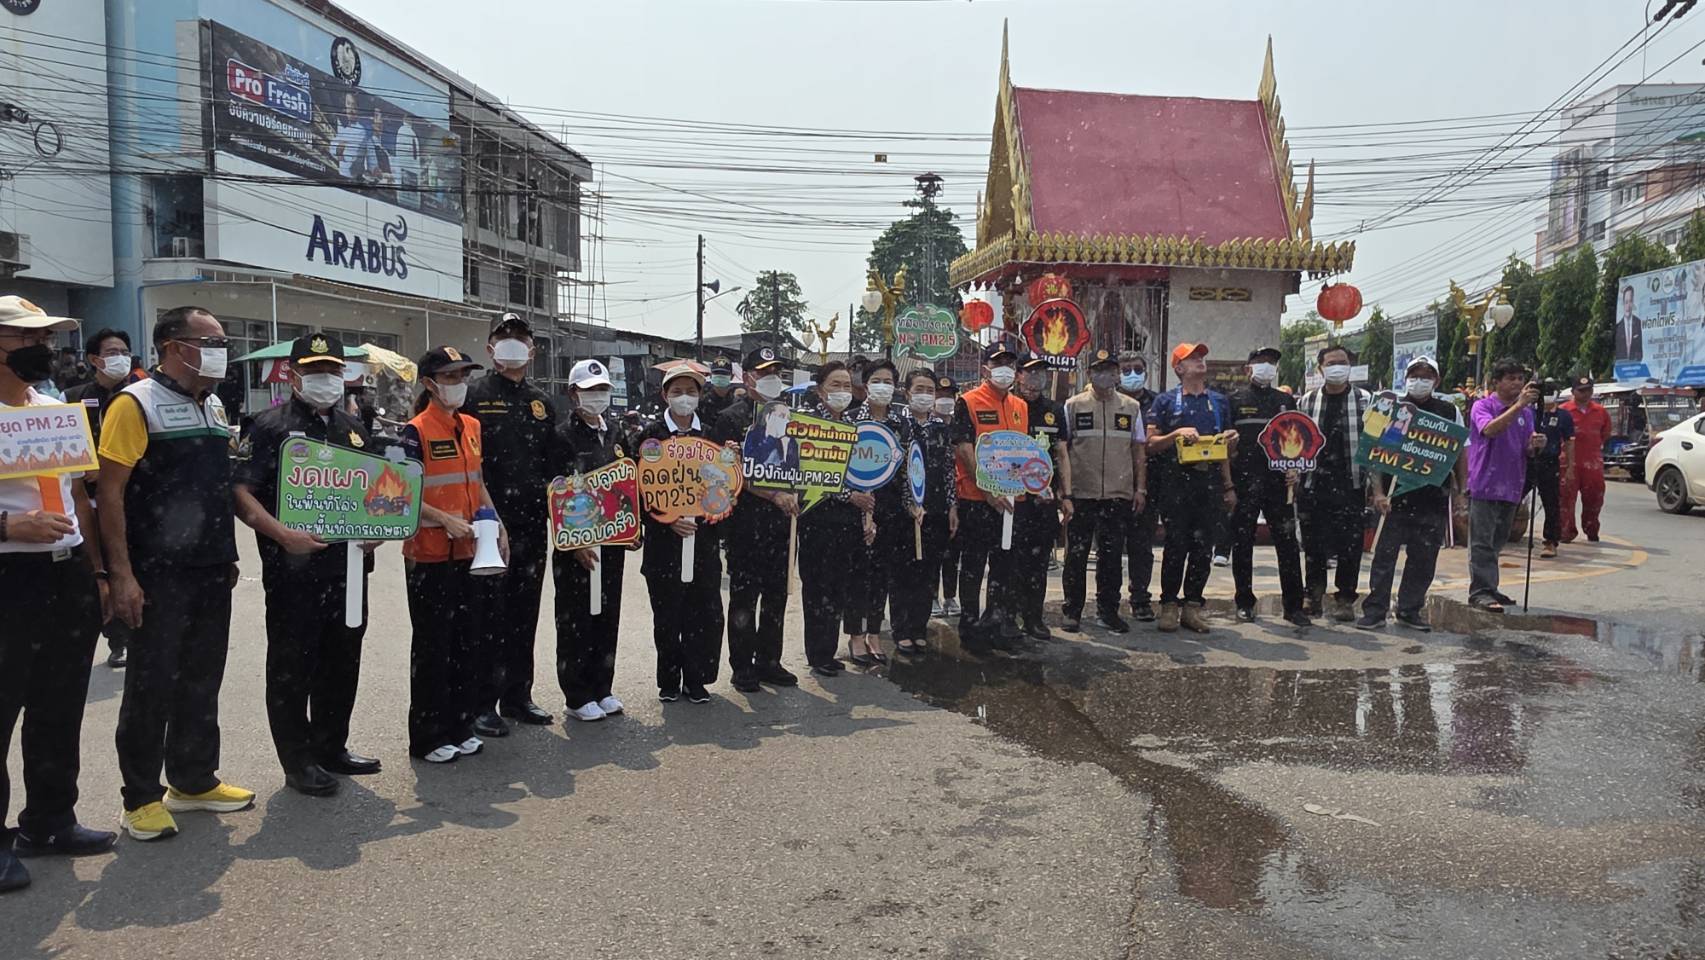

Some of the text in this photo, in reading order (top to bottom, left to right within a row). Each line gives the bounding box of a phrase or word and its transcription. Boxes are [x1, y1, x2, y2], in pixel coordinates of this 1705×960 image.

[235, 68, 263, 96] Pro
[267, 81, 308, 116] Fresh
[306, 214, 408, 280] ARABUS
[26, 417, 51, 431] PM
[54, 415, 77, 429] 2.5
[1417, 416, 1449, 432] ร่วมกัน
[667, 436, 715, 462] ร่วมใจ
[1368, 447, 1432, 475] PM 2.5
[287, 465, 369, 489] งดเผา
[642, 462, 703, 491] ลดฝุ่น
[805, 471, 822, 484] PM
[824, 473, 841, 485] 2.5
[286, 489, 358, 511] ในพื้นที่โล่ง
[644, 487, 696, 508] PM2.5
[557, 512, 636, 547] ครอบครัว
